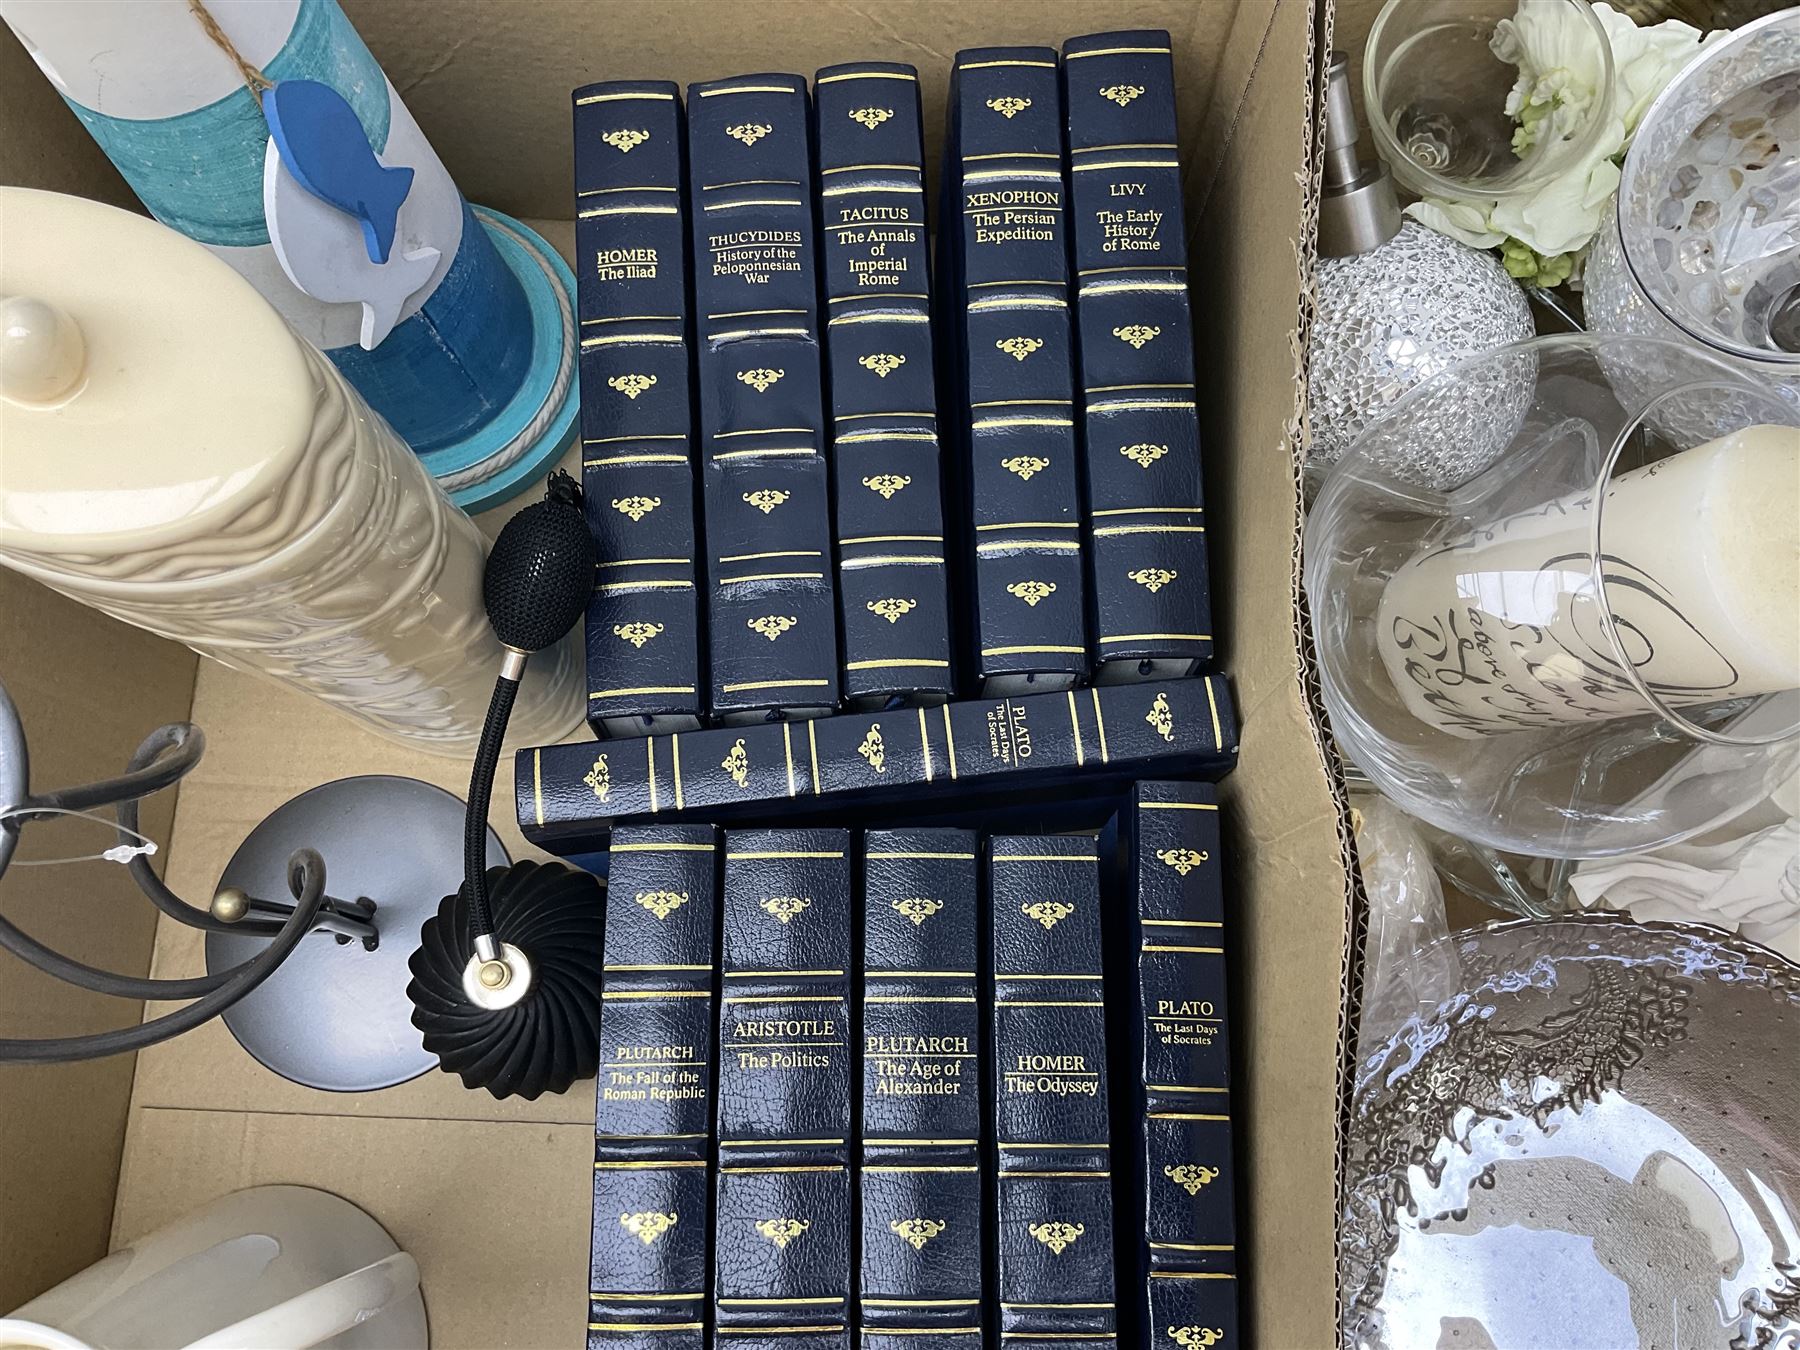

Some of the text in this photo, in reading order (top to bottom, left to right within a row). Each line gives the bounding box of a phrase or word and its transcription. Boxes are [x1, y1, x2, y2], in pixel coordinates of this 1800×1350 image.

[1110, 184, 1146, 196] LIVY
[967, 191, 1059, 207] XENOPHON
[840, 207, 909, 222] TACITUS
[972, 211, 1055, 227] The Persian
[1097, 209, 1163, 224] The Early
[709, 231, 800, 246] THUCYDIDES
[838, 229, 916, 245] The Annals
[976, 226, 1053, 245] Expedition
[1105, 225, 1157, 239] History
[871, 243, 886, 256] of
[1103, 238, 1160, 252] of Rome
[597, 249, 657, 264] HOMER
[717, 248, 796, 264] History of the
[598, 265, 656, 281] The Iliad
[713, 260, 801, 275] Peloponnesian
[849, 258, 907, 274] Imperial
[744, 273, 770, 284] War
[858, 273, 899, 286] Rome
[987, 711, 1000, 758] of Socrates
[996, 704, 1010, 764] The Last Days
[1012, 706, 1032, 758] PLATO
[1158, 1000, 1214, 1016] PLATO
[733, 1020, 835, 1037] ARISTOTLE
[1153, 1023, 1218, 1035] The Last Days
[866, 1037, 968, 1053] PLUTARCH
[1161, 1035, 1212, 1045] of Socrates
[616, 1046, 693, 1059] PLUTARCH
[737, 1052, 829, 1069] The Politics
[875, 1060, 961, 1079] The Age of
[1017, 1055, 1085, 1071] HOMER
[610, 1071, 699, 1085] The Fall of the
[603, 1086, 706, 1102] Roman Republic
[875, 1079, 961, 1095] Alexander
[1005, 1077, 1098, 1096] The Odyssey
